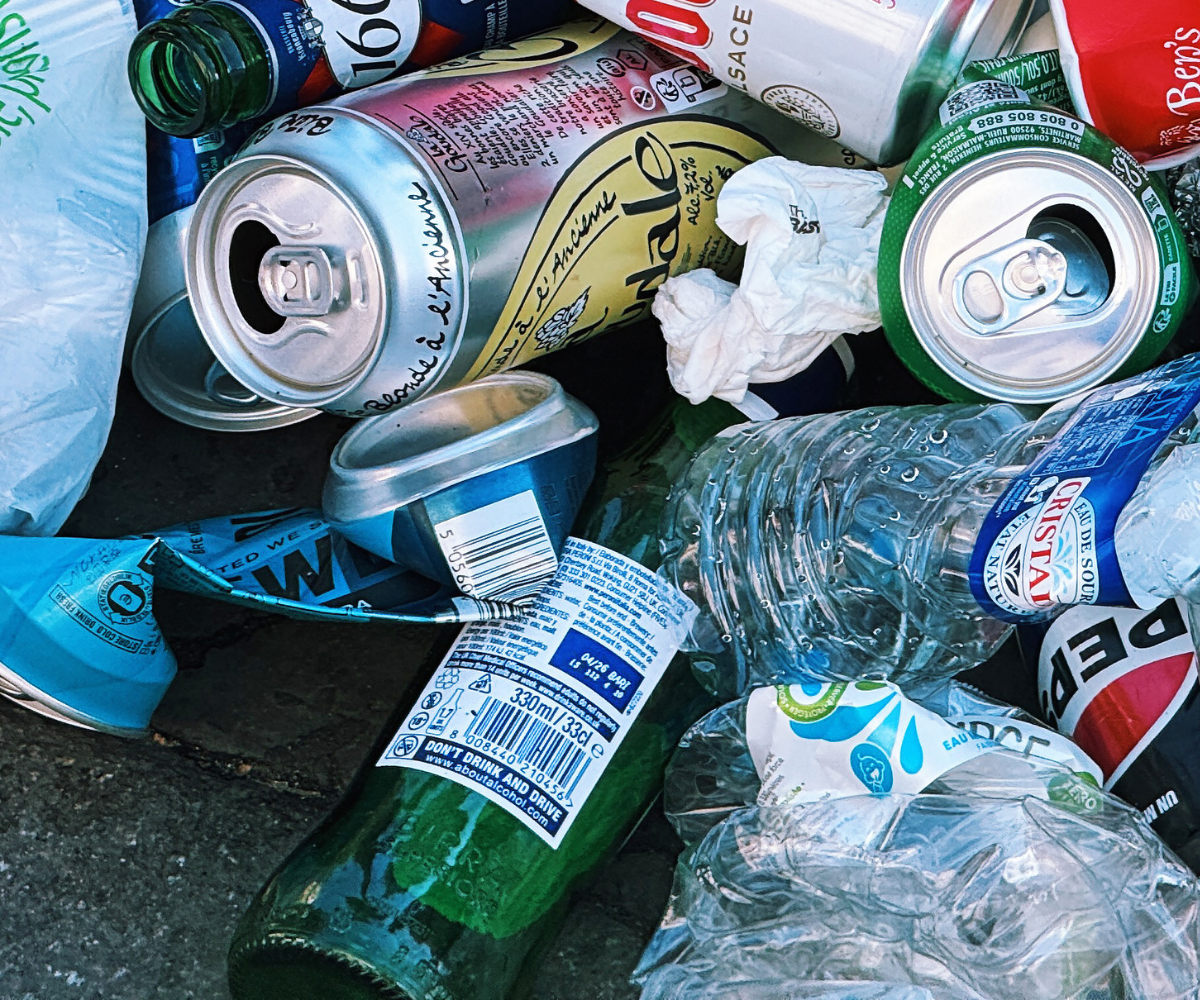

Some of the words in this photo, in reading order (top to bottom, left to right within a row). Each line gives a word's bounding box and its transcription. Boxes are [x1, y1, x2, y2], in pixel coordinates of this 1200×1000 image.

[564, 109, 588, 136] notre
[975, 114, 1003, 129] 888
[1007, 111, 1035, 122] 805
[1039, 113, 1066, 127] 805
[1069, 120, 1079, 130] 0
[983, 133, 1049, 147] CONSOMMATEURS
[1009, 125, 1035, 134] 92500
[1037, 125, 1081, 143] MARTINETS,
[936, 130, 967, 152] Service
[939, 126, 1007, 161] RUEIL-MALMAISON,
[1051, 135, 1080, 150] SERVICE
[946, 144, 982, 164] HEINEKEN,
[928, 170, 941, 182] RUE
[941, 163, 948, 171] 2
[1074, 503, 1089, 528] EAU
[1080, 528, 1093, 551] DE
[585, 593, 602, 607] Best
[598, 600, 619, 617] before
[578, 650, 610, 675] 04/26
[525, 668, 563, 694] recommend
[447, 727, 460, 740] 8
[463, 732, 517, 766] 008440
[518, 759, 568, 802] 210456
[423, 738, 464, 761] DON'T
[460, 750, 504, 781] DRINK
[500, 770, 530, 798] AND
[526, 788, 564, 823] DRIVE
[424, 751, 550, 827] www.aboutalcohol.com
